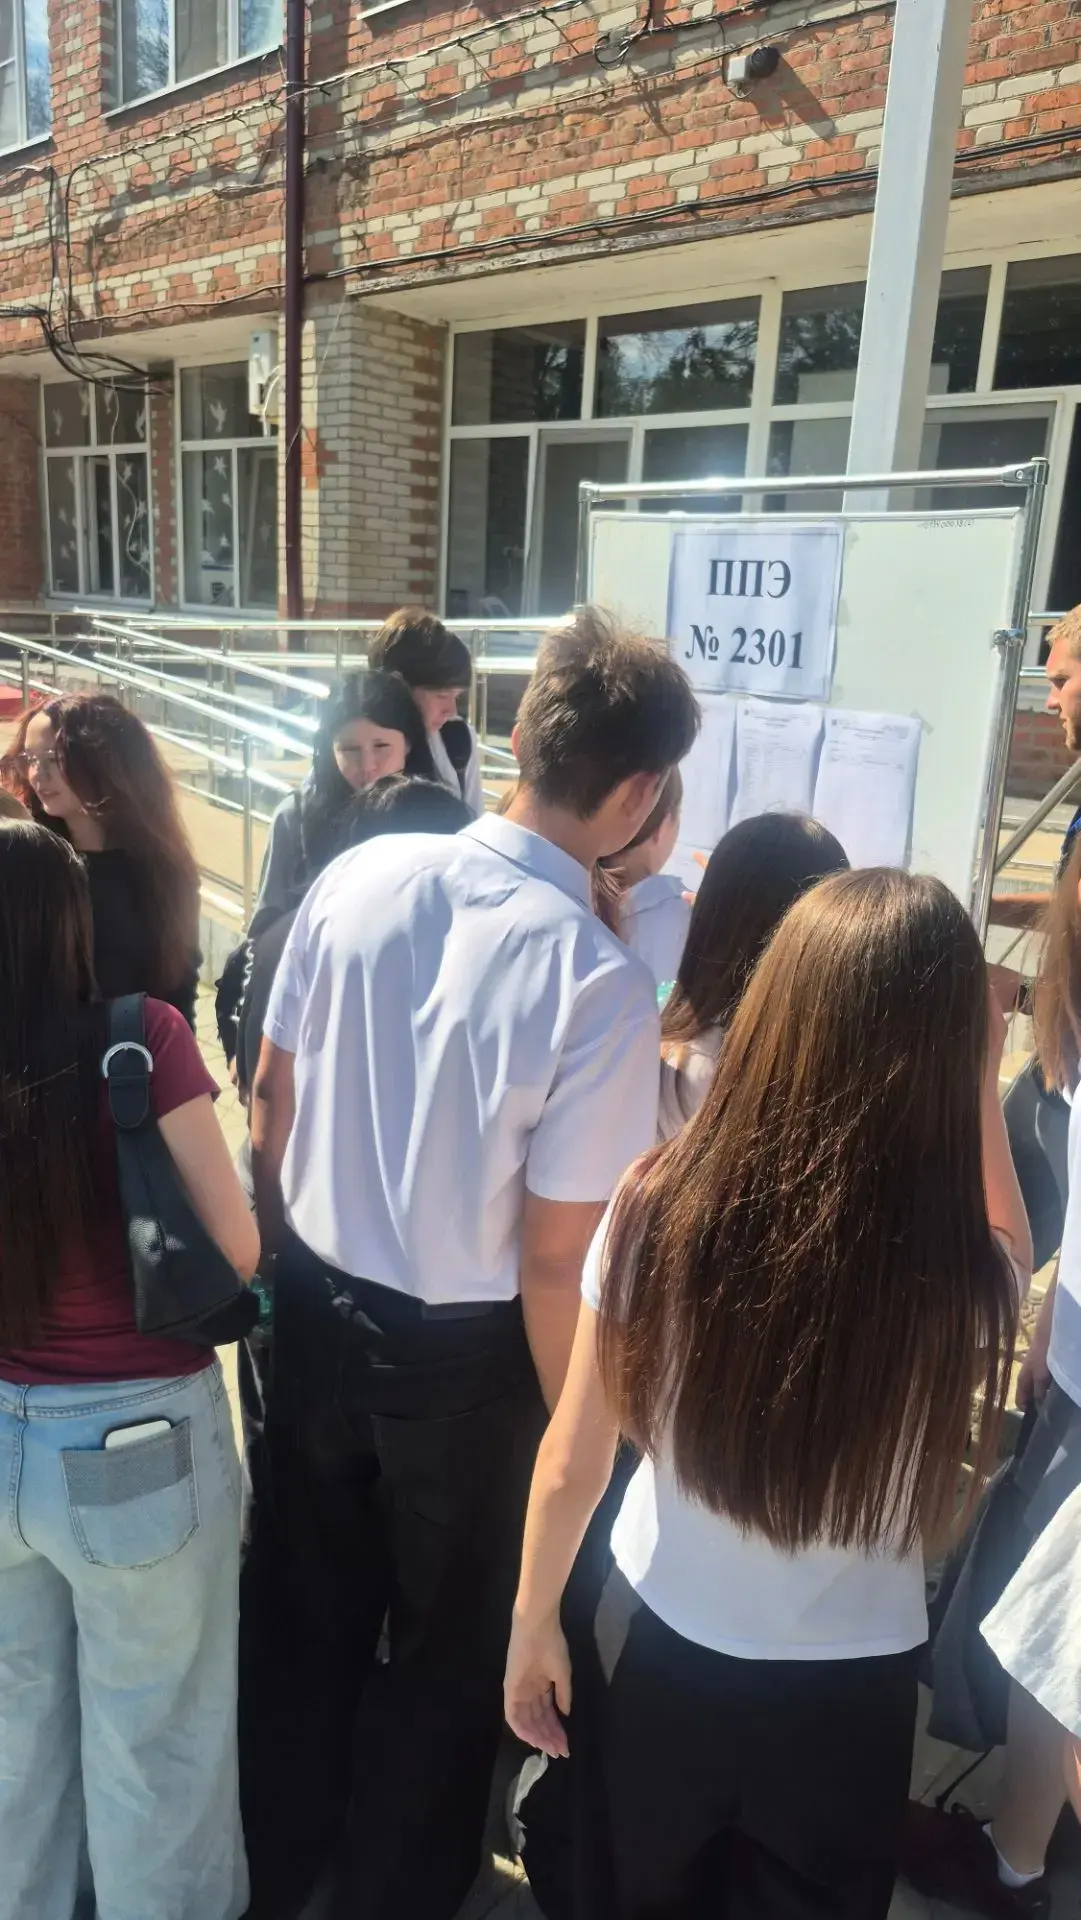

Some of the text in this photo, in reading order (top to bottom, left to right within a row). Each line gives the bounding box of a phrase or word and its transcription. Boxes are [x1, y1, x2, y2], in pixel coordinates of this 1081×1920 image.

[708, 559, 791, 599] ППЭ
[685, 624, 804, 669] № 2301
